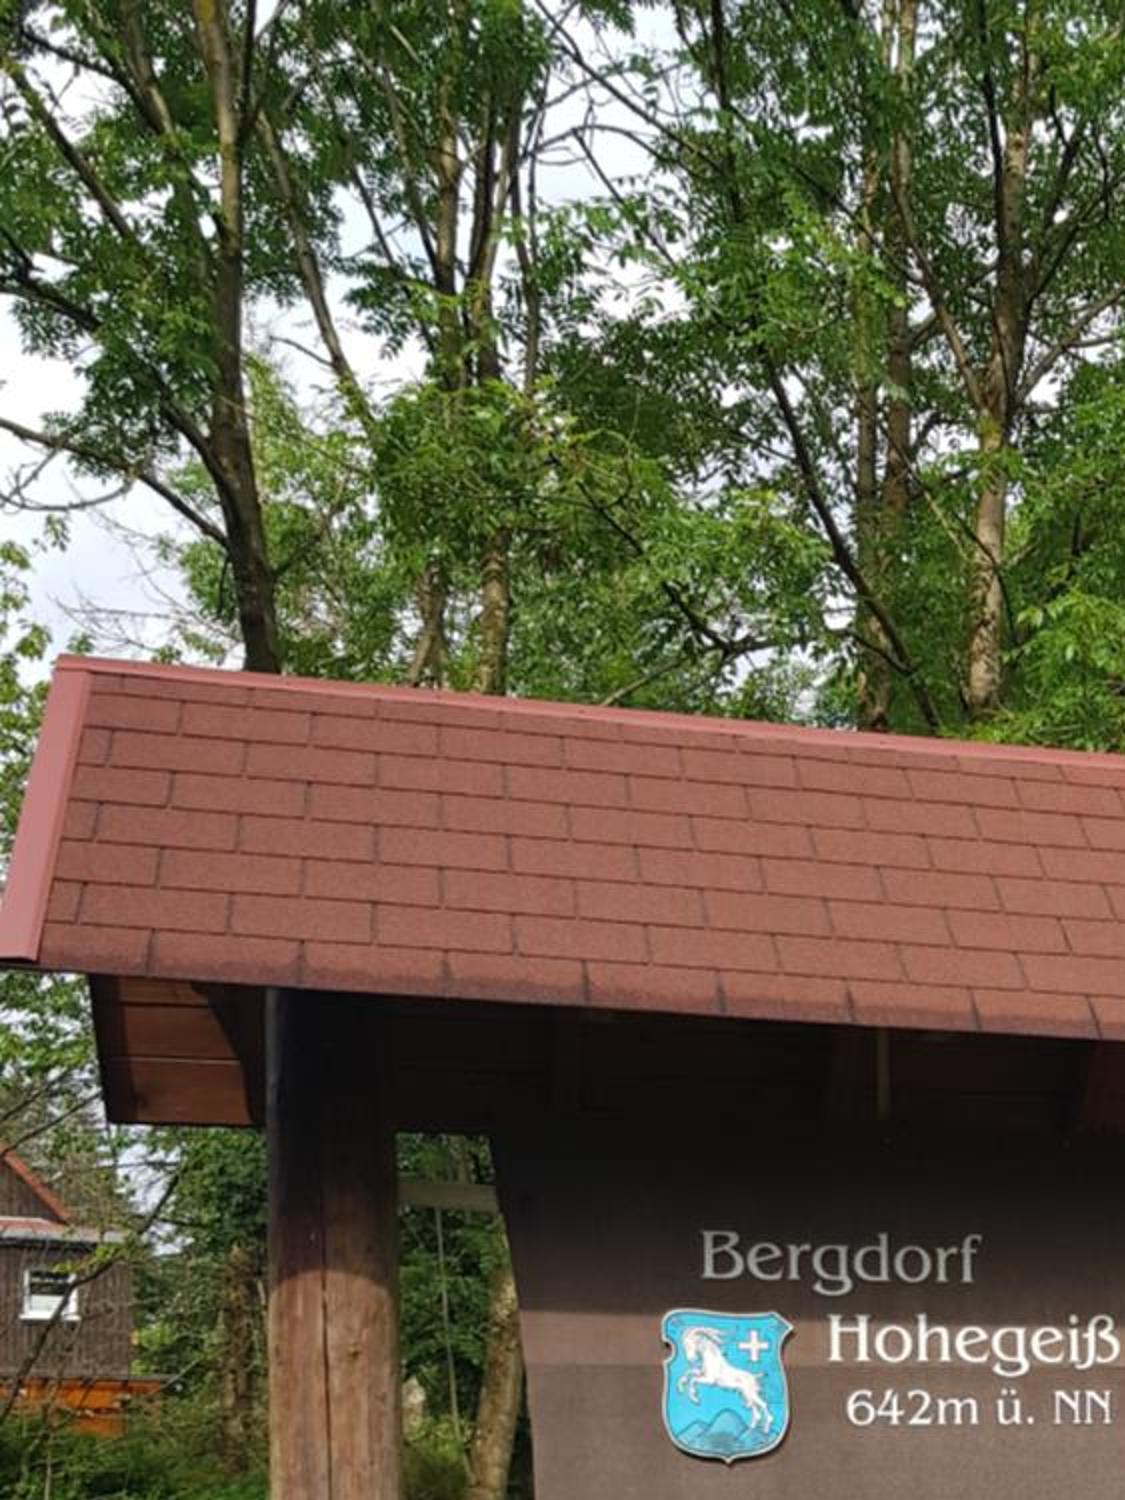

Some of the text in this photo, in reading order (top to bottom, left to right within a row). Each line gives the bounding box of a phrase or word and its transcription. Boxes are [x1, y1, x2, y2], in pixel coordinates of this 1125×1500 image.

[701, 1229, 983, 1297] Bergdorf
[826, 1313, 1121, 1377] Hohegeiß
[846, 1388, 1113, 1426] 642m ü. NN
